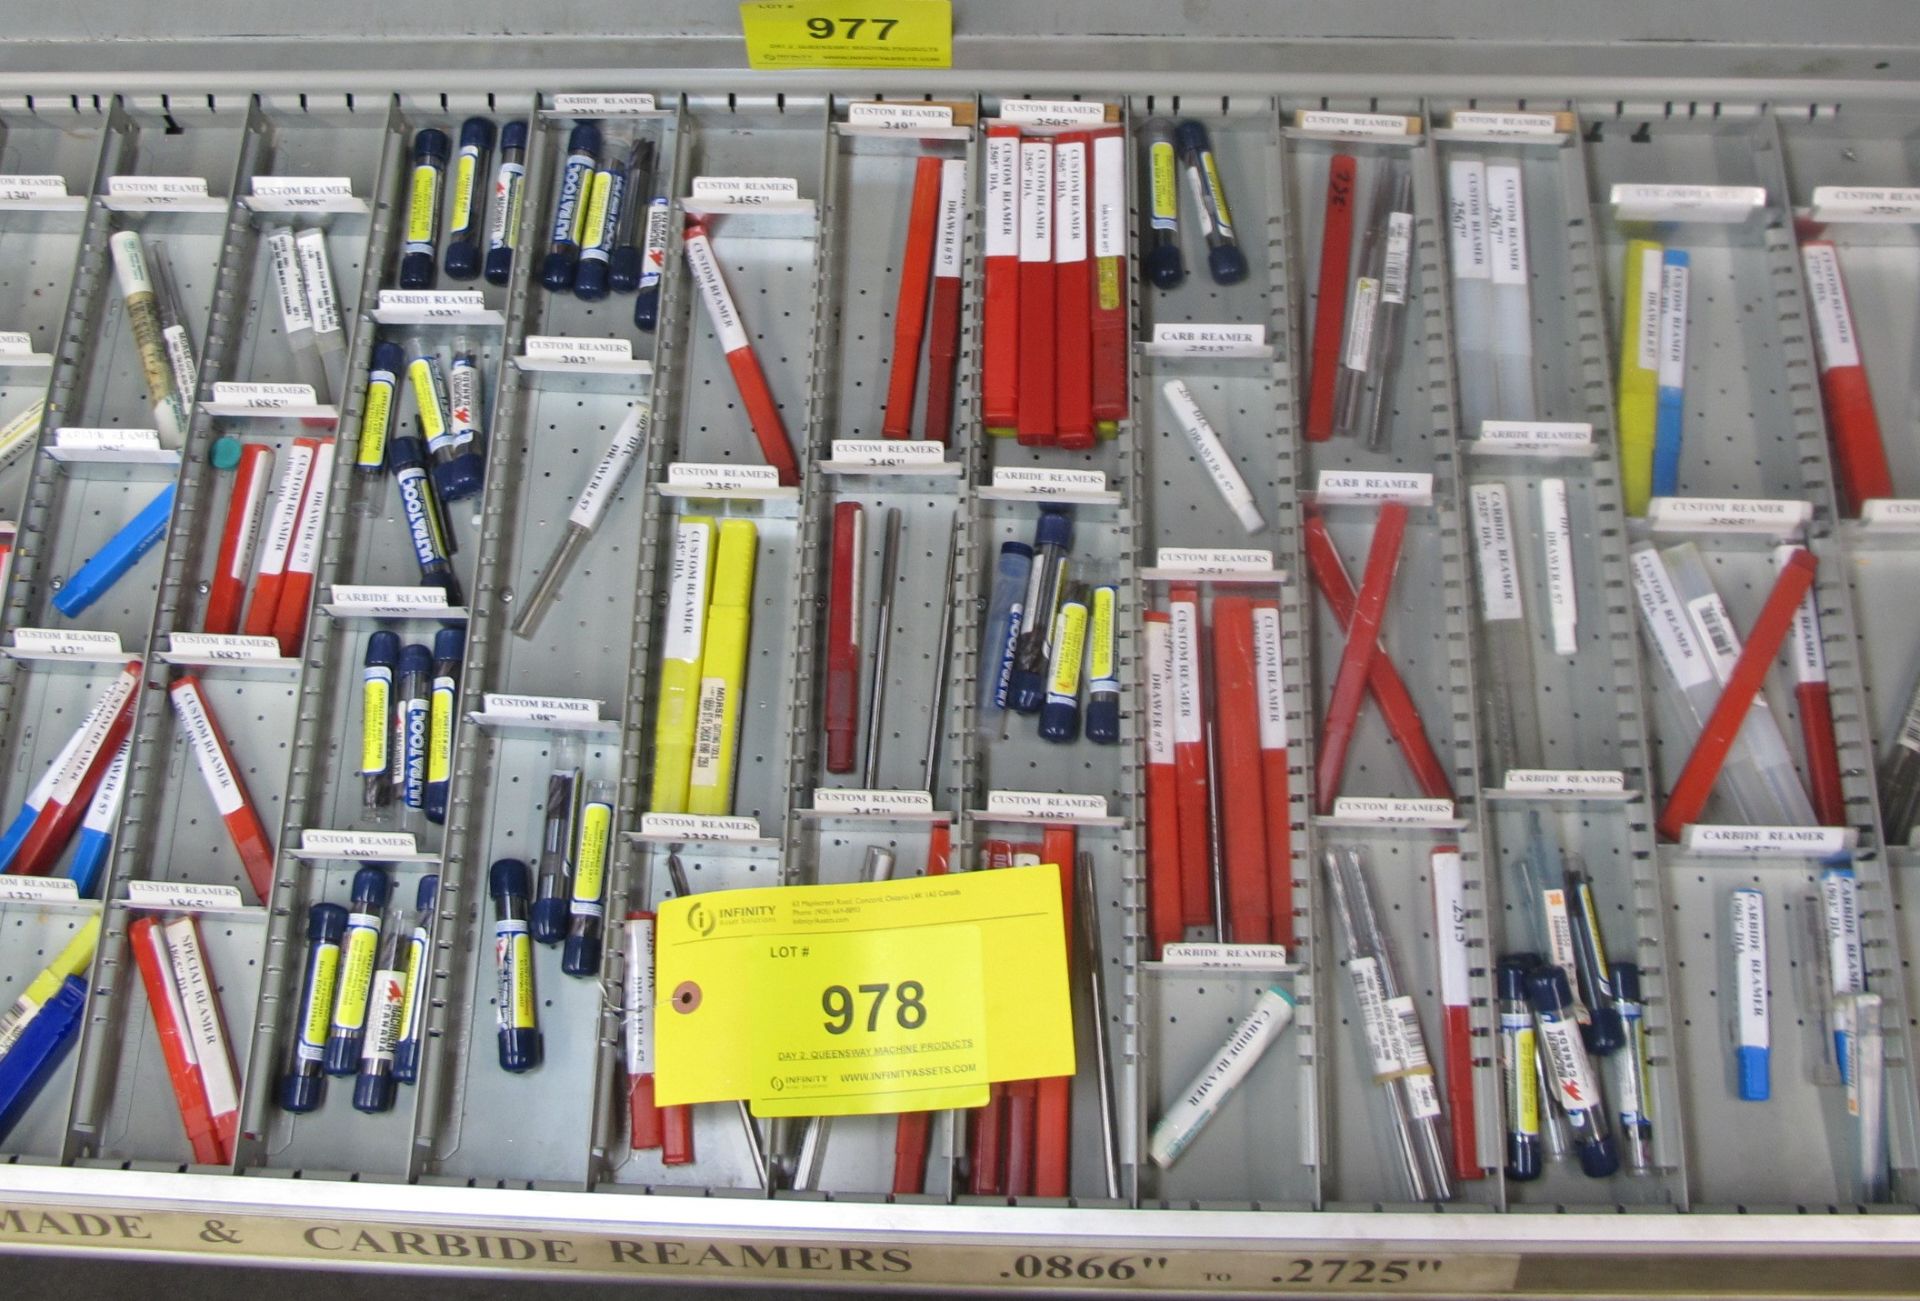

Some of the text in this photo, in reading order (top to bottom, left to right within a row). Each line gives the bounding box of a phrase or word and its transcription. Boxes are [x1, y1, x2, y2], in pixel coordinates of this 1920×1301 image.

[806, 17, 900, 41] 977
[555, 95, 653, 107] CARBIDE REAMERS
[1004, 103, 1102, 116] CUSTOM REAMERS
[853, 107, 951, 120] CUSTOM REAMERS
[1304, 115, 1403, 128] CUSTOM REAMERS
[112, 182, 156, 194] CUSTOM
[255, 185, 304, 197] CUSTOM
[696, 180, 795, 193] CUSTOM REAMERS
[989, 173, 998, 193] DIA.
[1002, 143, 1011, 235] CUSTOM REAMER
[1036, 149, 1045, 239] CUSTOM REAMER
[1070, 149, 1079, 239] CUSTOM REAMER
[554, 163, 581, 242] ULTRATOOL
[1469, 172, 1482, 264] CUSTOM REAMER
[1506, 178, 1519, 270] CUSTOM REAMER
[944, 199, 955, 266] DRAWER 57
[692, 240, 733, 328] CUSTOM REAMER
[380, 295, 432, 306] CARBIDE
[1820, 250, 1850, 344] CUSTOM REAMER
[1646, 291, 1656, 338] DRAWER
[1671, 267, 1683, 362] CUSTOM REAMER
[529, 340, 629, 354] CUSTOM REAMERS
[1160, 331, 1254, 343] CARB REAMER
[215, 383, 312, 397] CUSTOM REAMERS
[619, 434, 638, 460] DIA.
[1481, 429, 1530, 441] CARBIDE
[835, 444, 942, 456] CUSTOM REAMERS
[1188, 426, 1222, 474] DRAWER
[588, 443, 619, 491] DRAWER
[671, 466, 777, 479] CUSTOM REAMERS
[994, 470, 1104, 484] CARBIDE REAMERS
[1324, 477, 1418, 490] CARB REAMER
[274, 453, 308, 552] CUSTOM REAMER
[1671, 501, 1785, 515] CUSTOM REAMER
[298, 490, 323, 563] DRAWER 57
[399, 477, 435, 563] ULTRATOOL
[1479, 525, 1492, 550] DIA.
[1490, 490, 1513, 600] CARBIDE REAMER
[1159, 552, 1268, 564] CUSTOM REAMERS
[1545, 530, 1560, 582] DRAWER
[672, 559, 683, 582] DIA.
[682, 530, 700, 633] CUSTOM REAMER
[335, 592, 388, 603] CARBIDE
[1637, 554, 1694, 660] CUSTOM REAMER
[16, 629, 118, 645] CUSTOM REAMERS
[172, 634, 277, 650] CUSTOM REAMERS
[1177, 609, 1190, 717] CUSTOM REAMER
[1263, 615, 1279, 722] CUSTOM REAMER
[491, 697, 590, 711] CUSTOM REAMER
[715, 686, 724, 719] MORSE
[1151, 673, 1163, 752] DRAWER 57
[181, 689, 233, 789] CUSTOM REAMER
[105, 739, 132, 791] DRAWER
[405, 708, 428, 806] ULTRATOOL
[1508, 774, 1624, 786] CARBIDE REAMERS
[816, 792, 929, 806] CUSTOM REAMERS
[991, 795, 1041, 807] CUSTOM
[1338, 801, 1451, 814] CUSTOM REAMERS
[646, 817, 758, 832] CUSTOM REAMERS
[1702, 829, 1826, 843] CARBIDE REAMER
[305, 834, 414, 849] CUSTOM REAMERS
[132, 882, 240, 897] CUSTOM REAMERS
[719, 905, 777, 919] INFINITY
[1838, 877, 1856, 937] CARBIDE
[770, 945, 798, 958] LOT
[1166, 947, 1285, 960] CARBIDE REAMERS
[1745, 893, 1764, 1017] CARBIDE REAMER
[179, 932, 220, 1046] SPECIAL REAMER
[632, 976, 643, 1036] DRAWER
[821, 979, 928, 1035] 978
[375, 1003, 393, 1052] CANADA
[778, 1038, 974, 1061] DAY QUEENSWAY MACHINE PRODUCTS
[1186, 1007, 1271, 1109] CARBIDE REAMER
[1544, 1027, 1569, 1079] MACHINERY
[1556, 1028, 1579, 1079] CANADA
[785, 1075, 828, 1085] INFINITY
[840, 1063, 977, 1083] WWW.INFINITYASSETS.COM
[0, 1208, 1444, 1285] MADE & CARBIDE REAMERS .0866" TO .2725"
